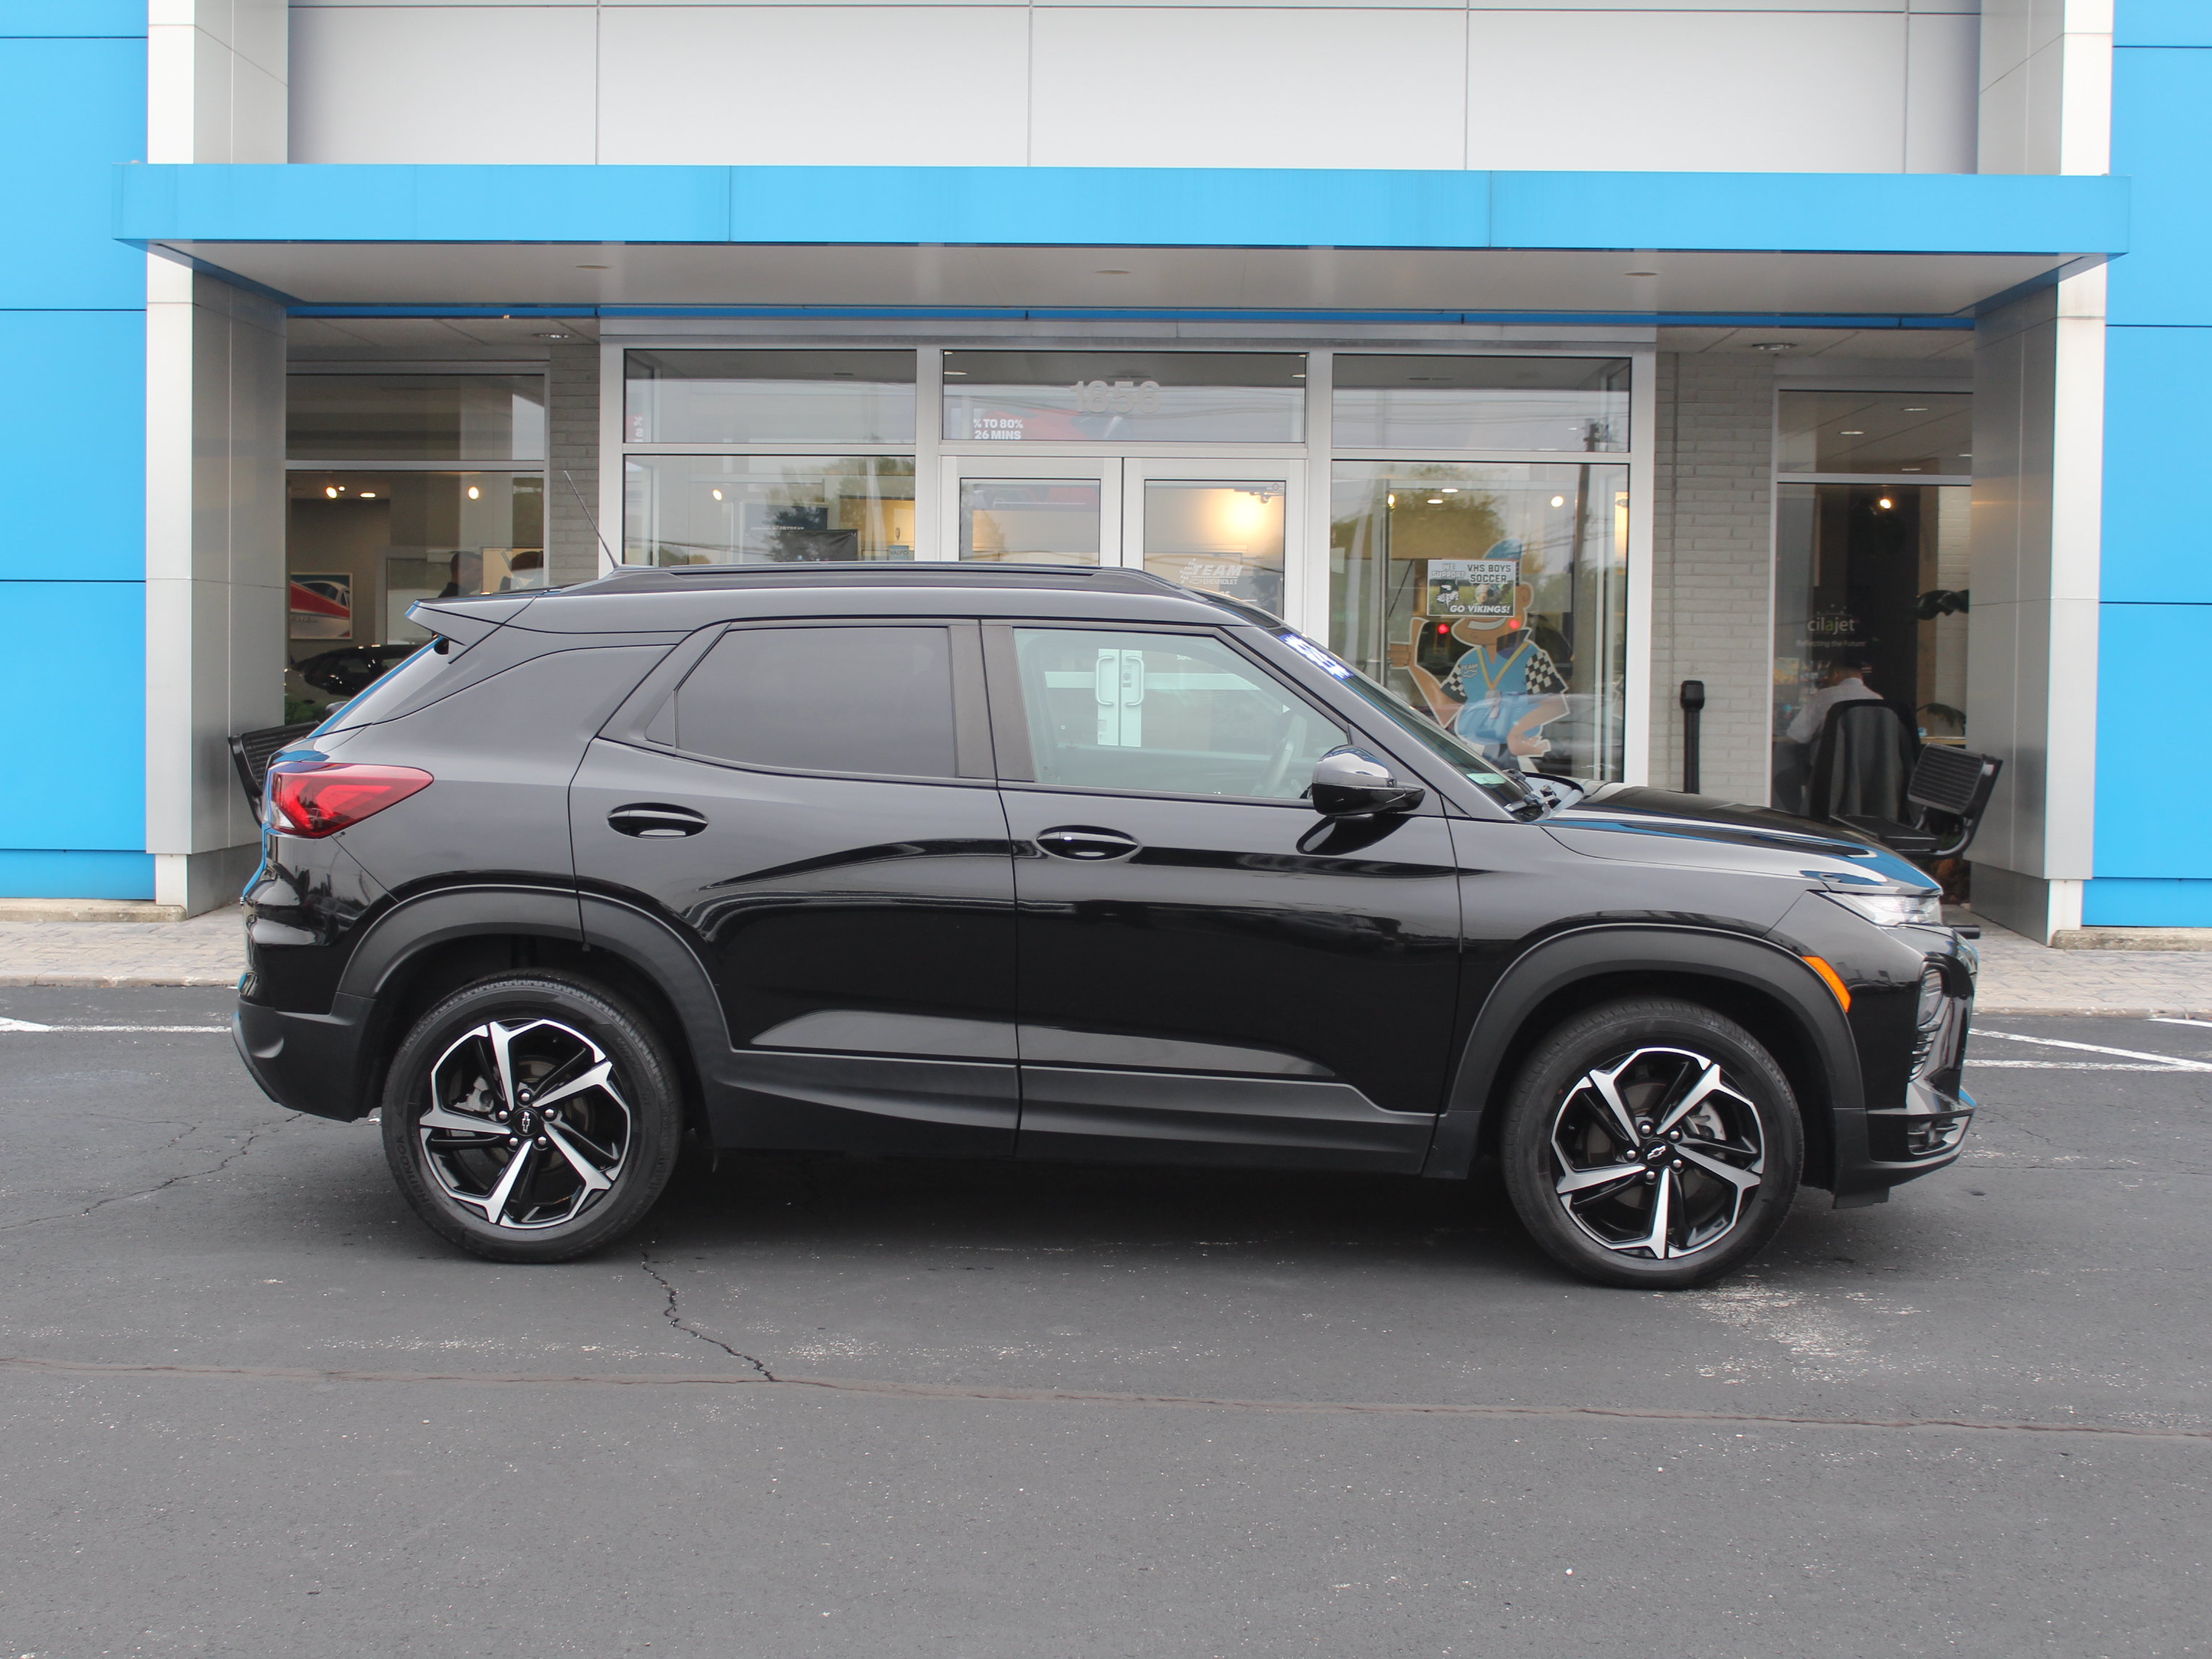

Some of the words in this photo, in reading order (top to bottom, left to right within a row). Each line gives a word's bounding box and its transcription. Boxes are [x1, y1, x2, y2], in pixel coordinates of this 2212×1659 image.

[1070, 380, 1161, 413] 1856
[983, 418, 998, 428] TO
[999, 418, 1024, 428] 80%
[974, 430, 989, 439] 26
[991, 430, 1022, 439] MINS
[1192, 565, 1244, 576] TEAM
[1467, 564, 1485, 572] VHS
[1488, 564, 1511, 572] BOYS
[1470, 574, 1507, 583] SOCCER
[1468, 605, 1511, 613] VIKINGS!
[1807, 616, 1856, 635] cilajet
